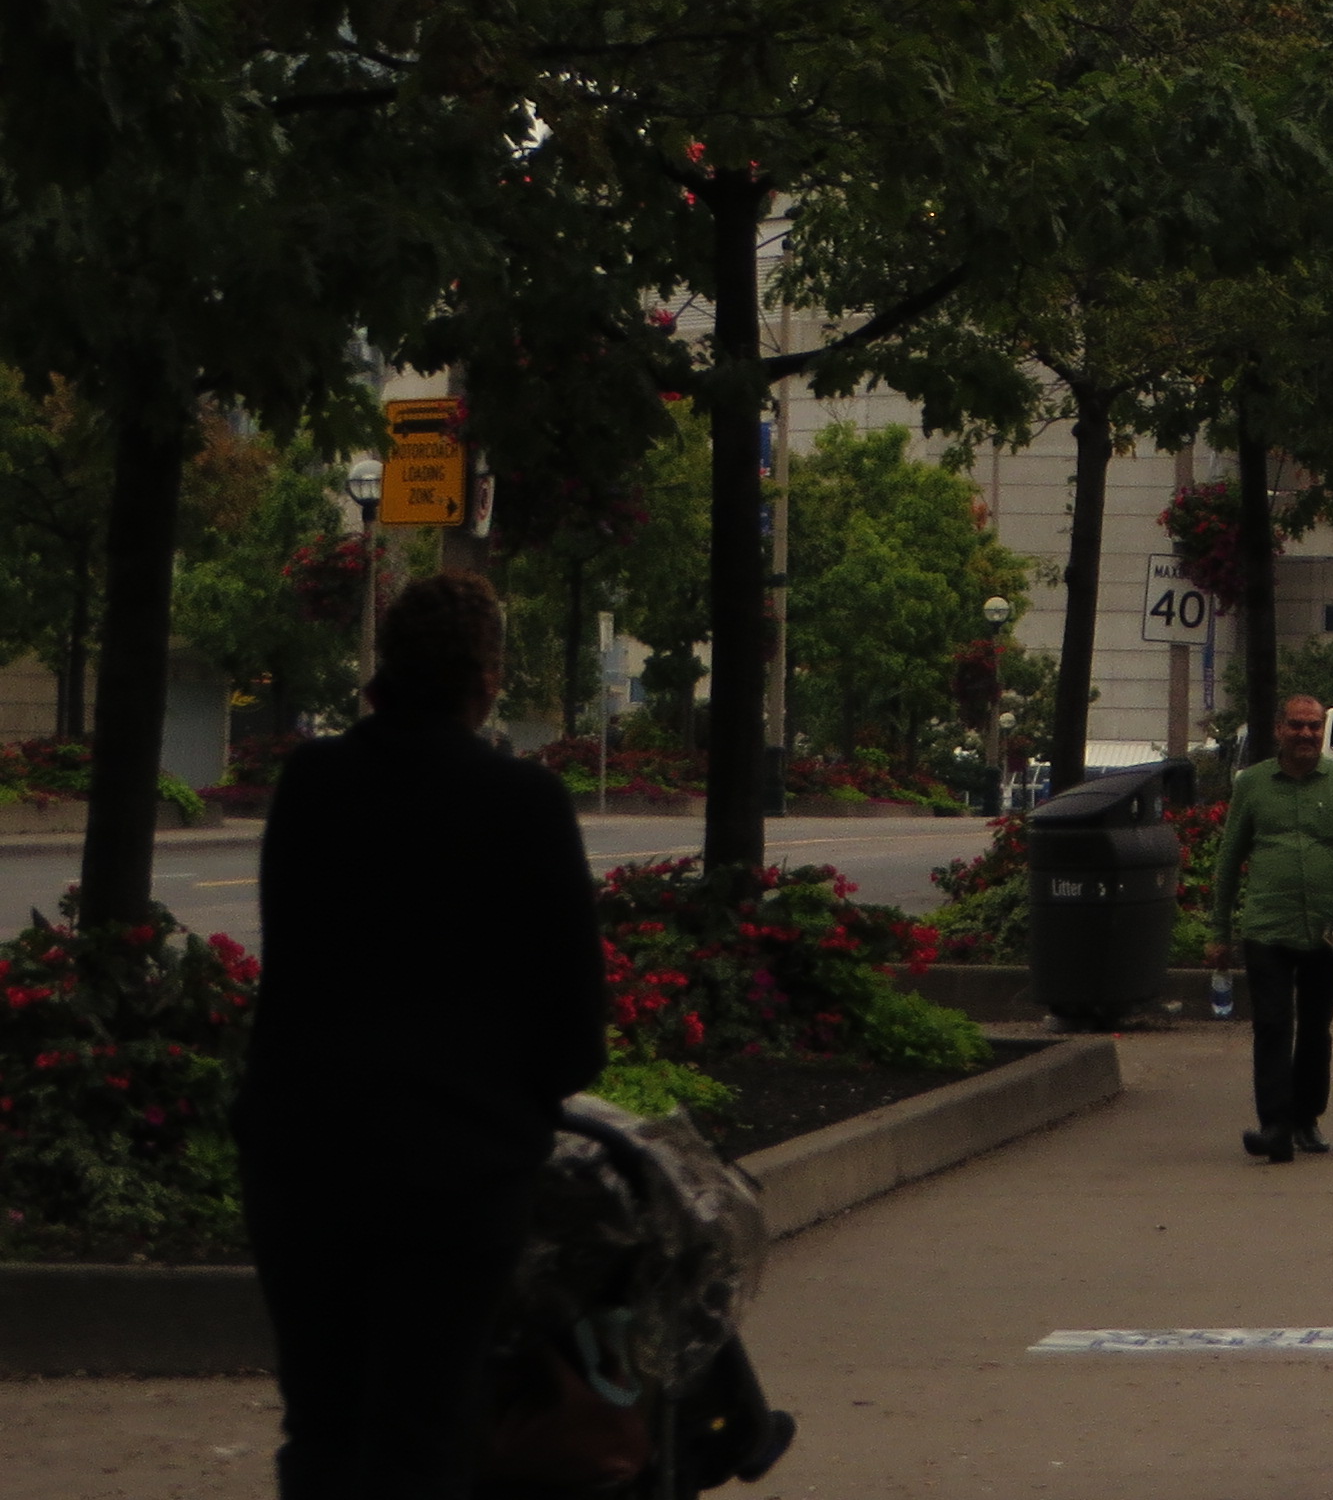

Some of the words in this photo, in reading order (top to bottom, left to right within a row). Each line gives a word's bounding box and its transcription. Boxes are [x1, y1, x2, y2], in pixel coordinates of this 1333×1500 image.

[402, 465, 445, 482] LOADING
[408, 488, 436, 505] ZONE
[1150, 589, 1205, 629] 40
[1052, 878, 1083, 897] Litter
